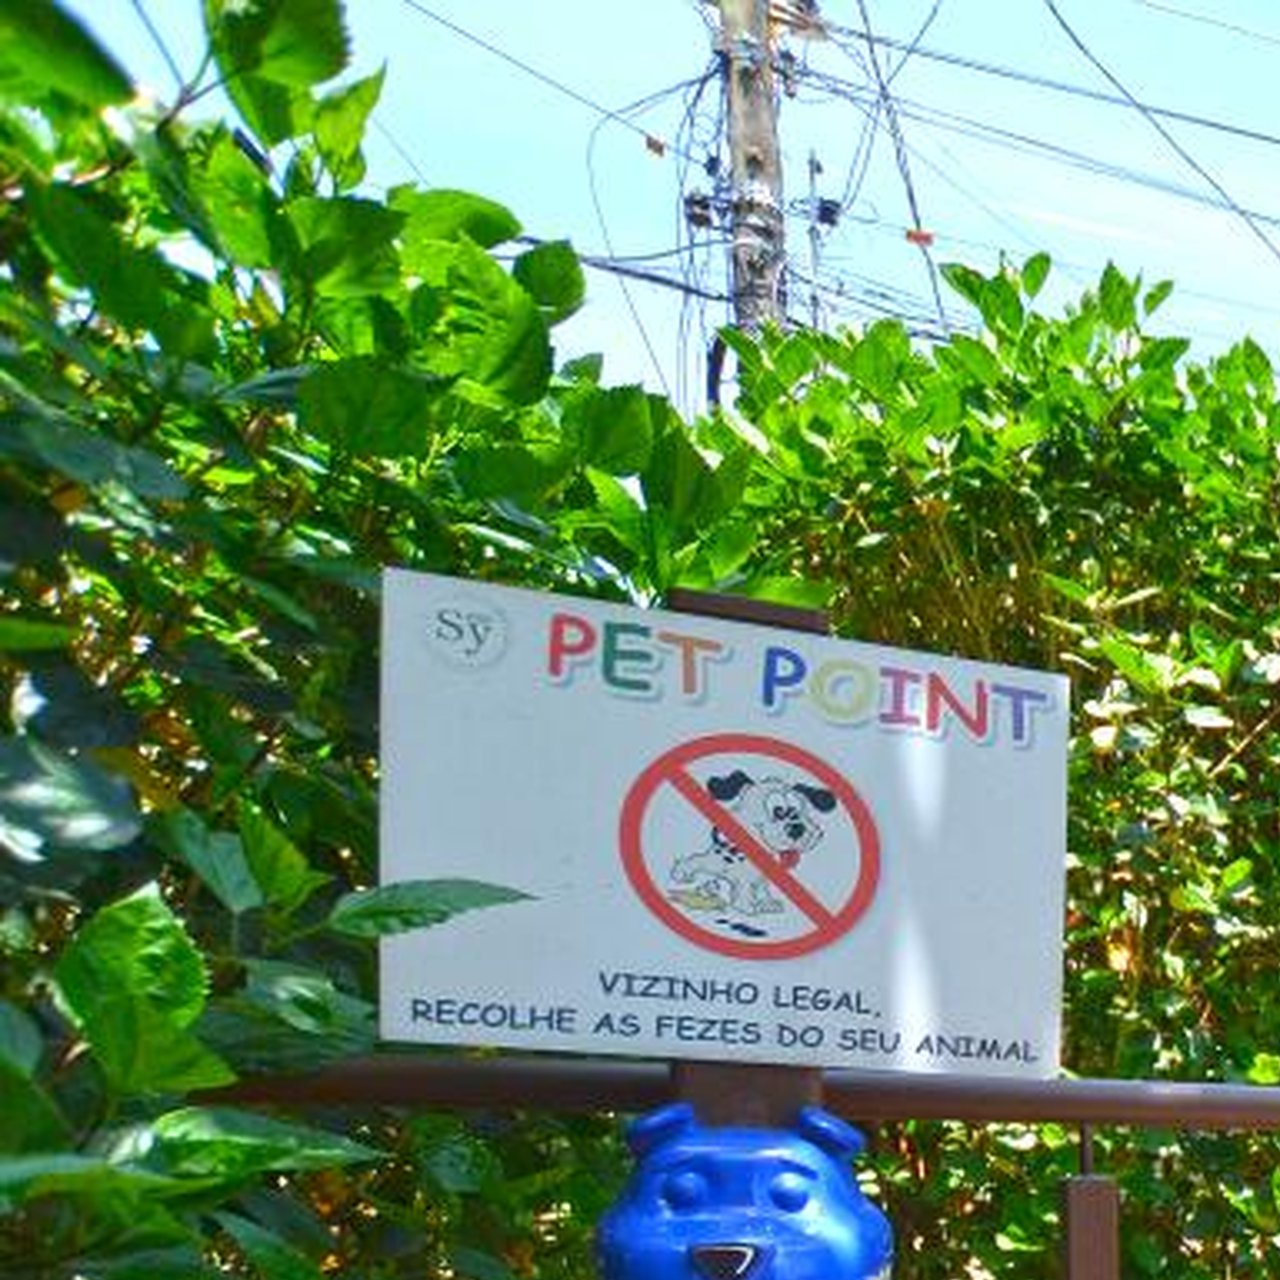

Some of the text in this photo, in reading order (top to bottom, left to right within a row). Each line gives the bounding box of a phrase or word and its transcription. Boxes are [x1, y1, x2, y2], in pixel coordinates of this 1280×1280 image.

[546, 613, 1047, 741] PET POINT
[600, 973, 882, 1018] VIZINHO LEGAL,
[411, 999, 1038, 1063] RECOLHE AS FEZES DO SEU ANIMAL
